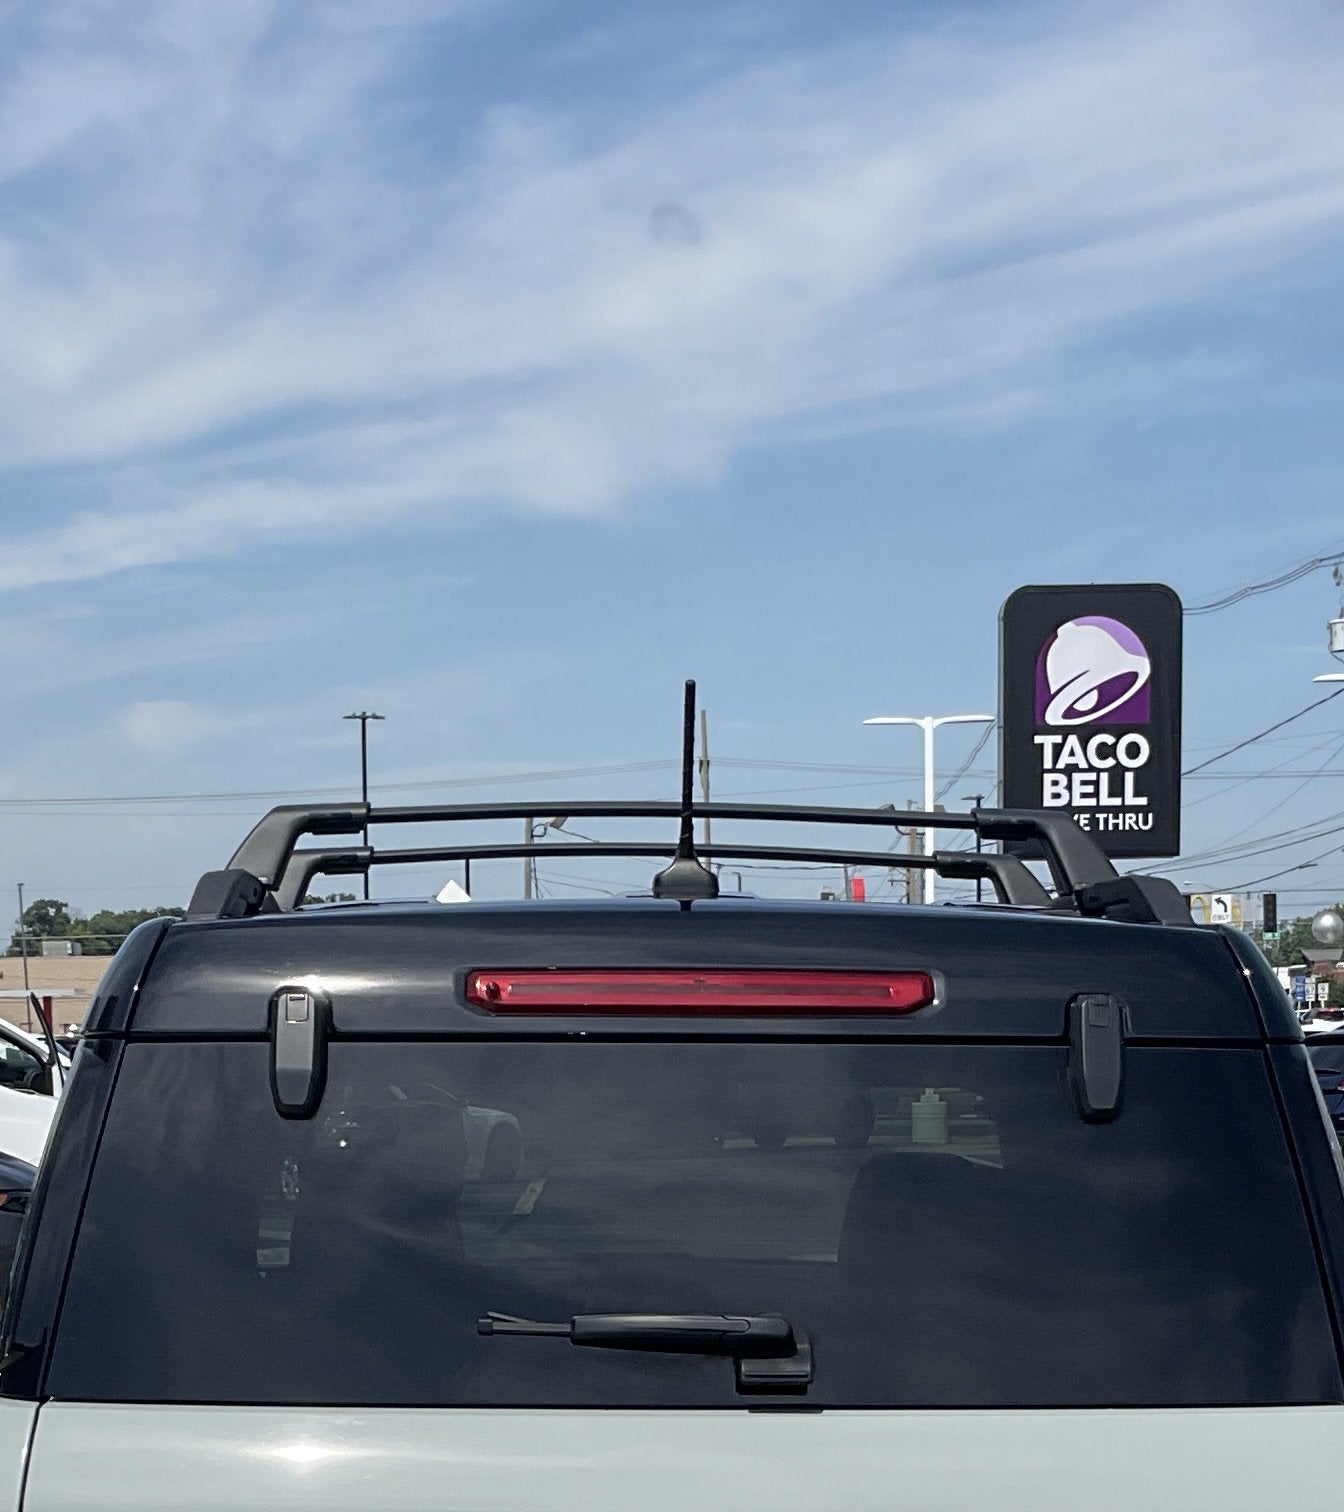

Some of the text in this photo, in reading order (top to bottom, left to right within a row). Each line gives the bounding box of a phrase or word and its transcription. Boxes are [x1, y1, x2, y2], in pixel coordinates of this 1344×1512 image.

[1033, 733, 1150, 769] TACO
[1042, 772, 1147, 807] BELL
[1096, 813, 1153, 831] THRU
